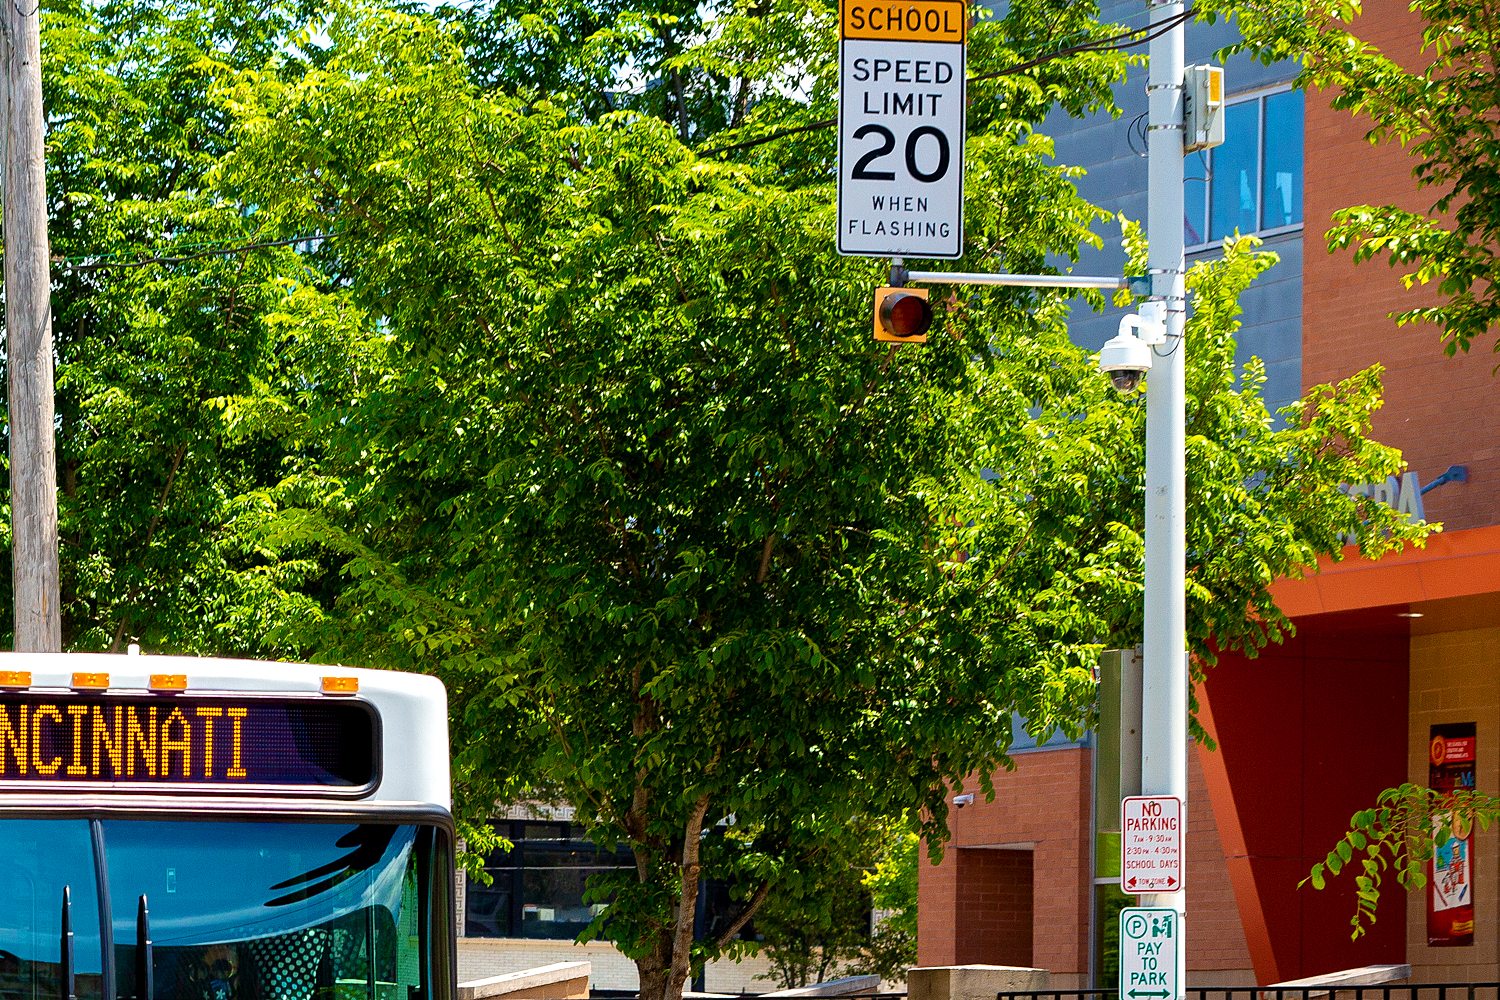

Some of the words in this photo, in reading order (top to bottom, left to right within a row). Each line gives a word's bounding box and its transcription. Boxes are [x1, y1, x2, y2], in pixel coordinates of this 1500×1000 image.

[850, 6, 958, 33] SCHOOL
[852, 57, 953, 84] SPEED
[863, 91, 943, 117] LIMIT
[851, 123, 951, 183] 20
[872, 195, 928, 212] WHEN
[848, 219, 950, 238] FLASHING
[1142, 802, 1162, 817] NO
[1127, 817, 1177, 831] PARKING
[1126, 860, 1156, 869] SCHOOL
[1159, 859, 1178, 869] DAYS
[1137, 942, 1163, 955] PAY
[1141, 956, 1158, 970] TO
[1130, 972, 1167, 985] PARK
